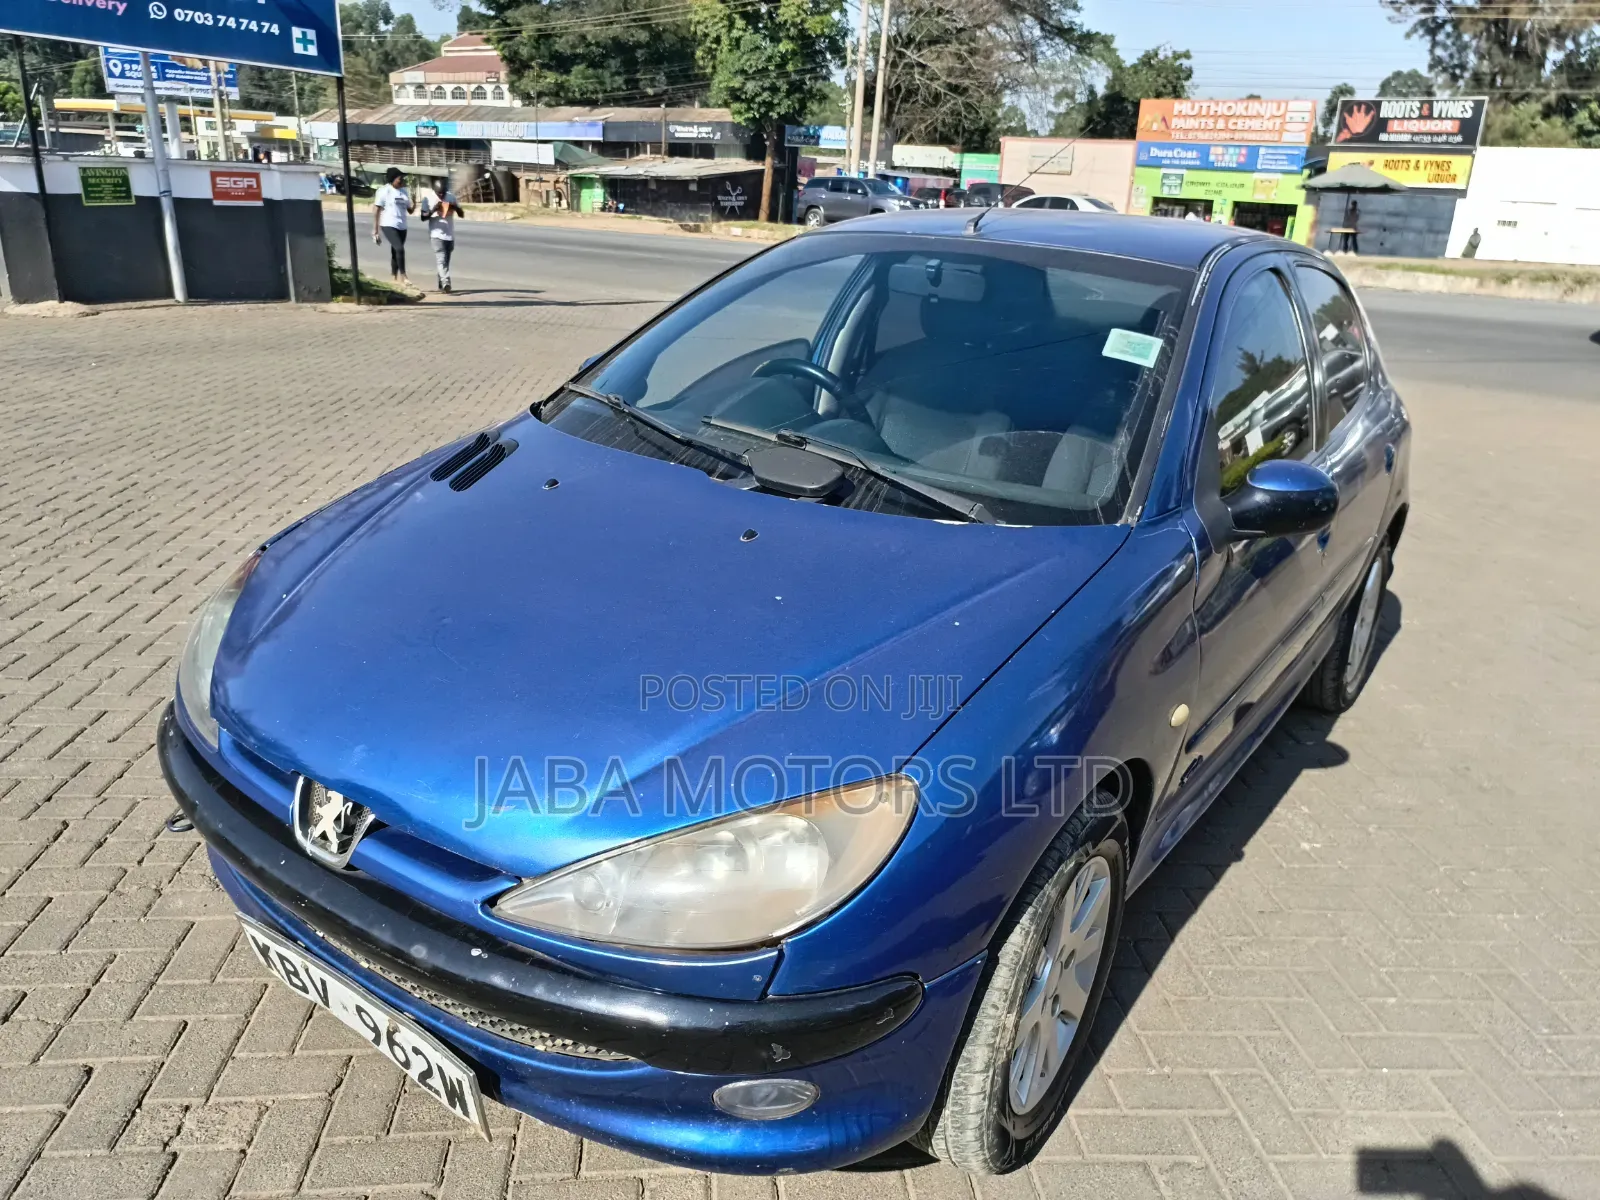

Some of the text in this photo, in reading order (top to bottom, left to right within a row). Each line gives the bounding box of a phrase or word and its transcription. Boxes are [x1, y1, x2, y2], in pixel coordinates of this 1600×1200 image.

[174, 8, 280, 35] 0703 74 74 74
[125, 70, 158, 79] SQUE
[131, 64, 157, 72] PAK
[1173, 101, 1286, 118] MUTHOKINJU
[1380, 101, 1474, 118] ROOTS & VYNES
[1171, 117, 1283, 131] PAINTS & CEMENT
[1393, 119, 1454, 131] LIQUOR
[1383, 159, 1452, 172] ROOTS & VYNES
[80, 168, 128, 177] LAVINGTON
[1427, 173, 1457, 184] LIQUOR
[216, 176, 257, 189] SGA
[251, 934, 470, 1119] KBV 962W
